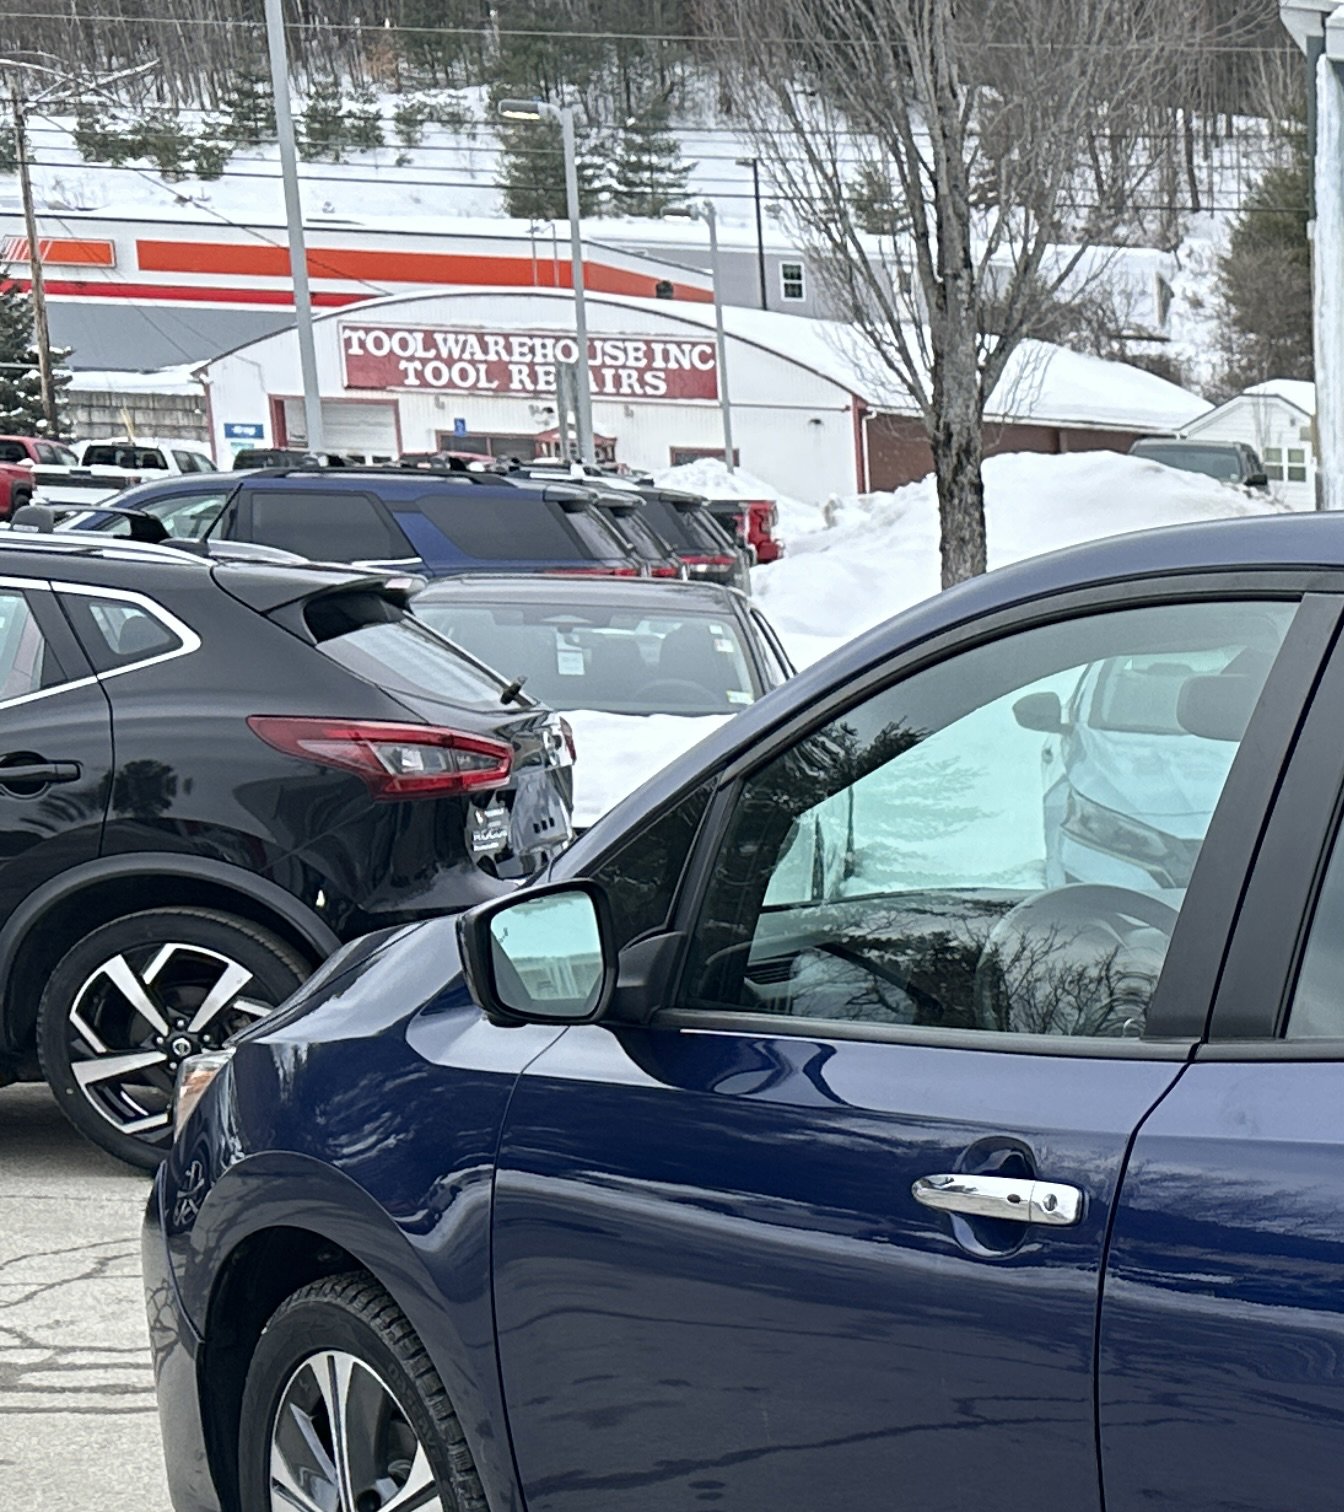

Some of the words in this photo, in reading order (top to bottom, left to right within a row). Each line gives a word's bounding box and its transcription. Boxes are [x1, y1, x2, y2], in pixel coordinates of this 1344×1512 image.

[651, 342, 715, 371] INC
[399, 360, 499, 388] TOOL
[508, 363, 668, 395] REIRS
